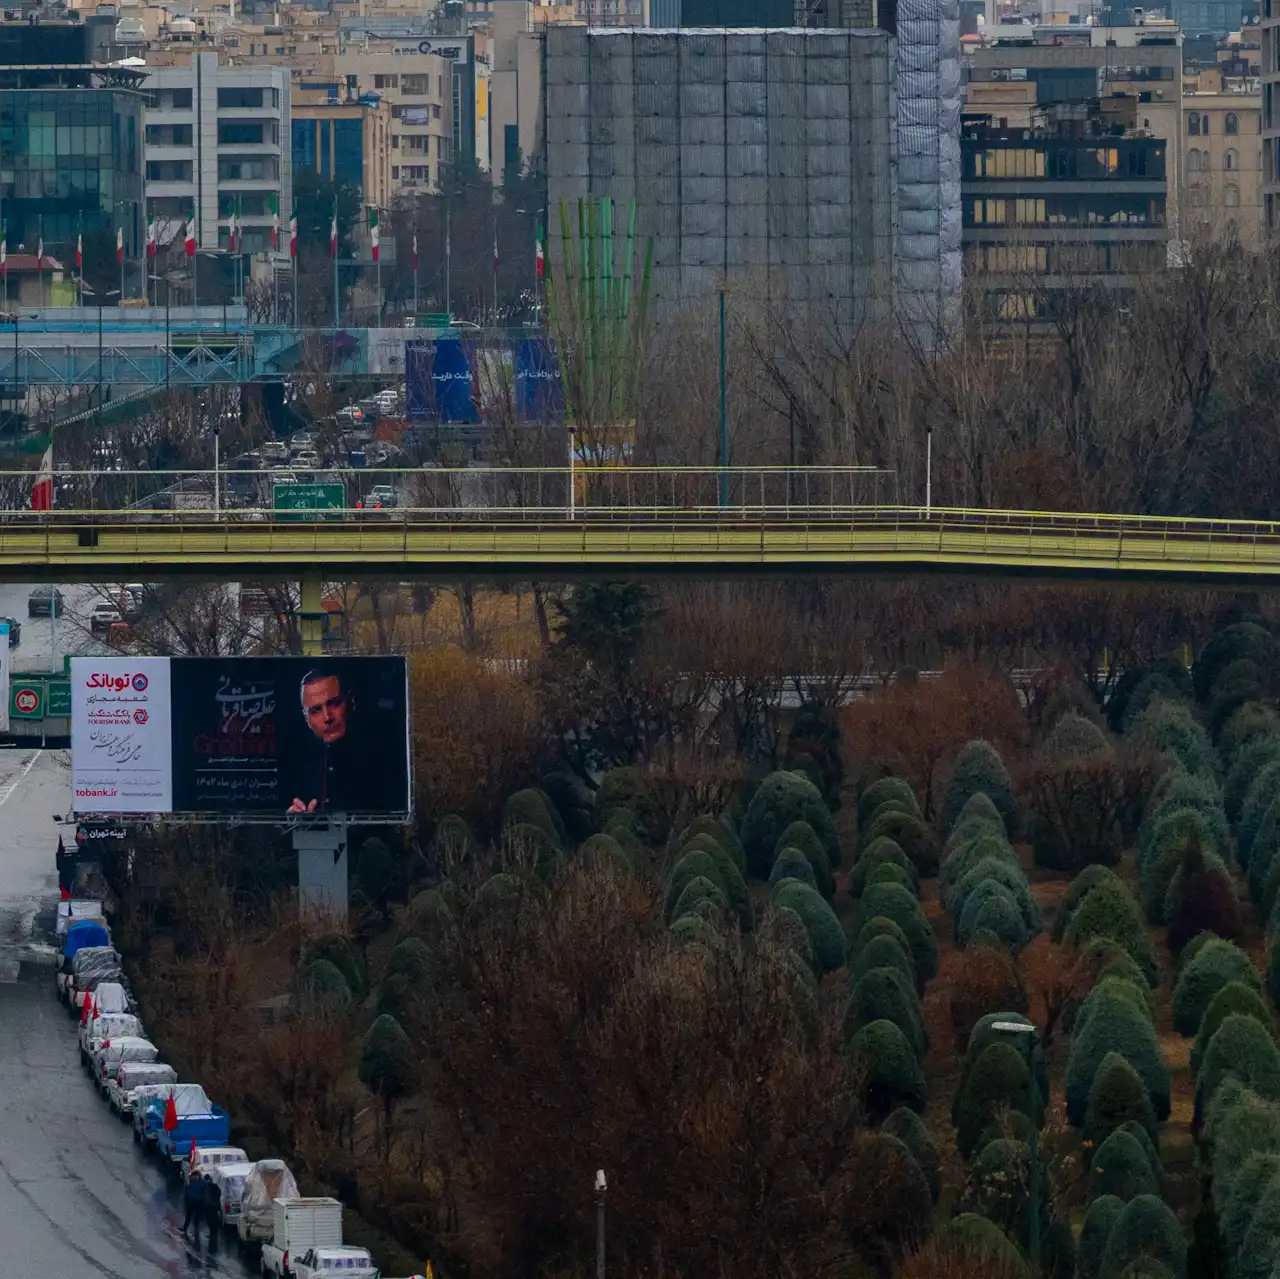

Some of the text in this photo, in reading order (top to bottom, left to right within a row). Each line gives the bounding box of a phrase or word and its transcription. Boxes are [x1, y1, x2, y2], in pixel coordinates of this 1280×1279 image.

[86, 673, 130, 692] توبانک
[196, 777, 216, 787] ۱۴۰۲
[230, 779, 243, 789] دی
[248, 777, 278, 788] تهران
[76, 788, 118, 797] tobank.ir
[89, 828, 110, 838] تهران
